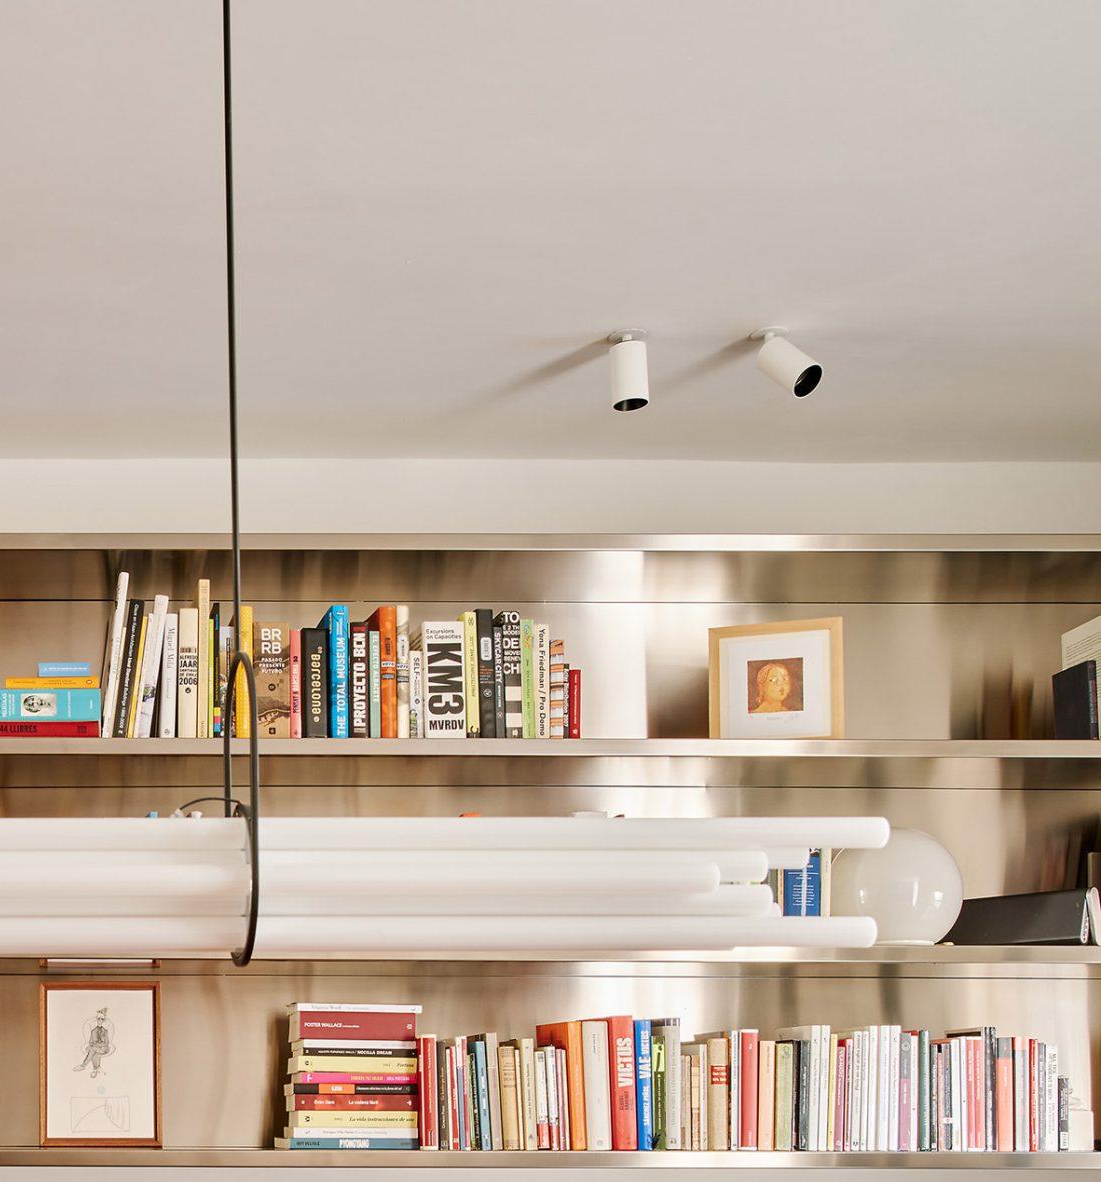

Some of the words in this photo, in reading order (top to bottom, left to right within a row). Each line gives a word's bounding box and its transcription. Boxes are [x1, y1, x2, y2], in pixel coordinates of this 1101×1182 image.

[503, 611, 519, 623] TO
[261, 628, 282, 641] BR
[353, 632, 366, 657] BCN
[503, 638, 519, 650] DE
[261, 641, 282, 655] RB
[335, 637, 345, 679] MUSEUM
[493, 632, 502, 665] SKYCAR
[179, 660, 198, 668] JAAR
[494, 665, 502, 683] CITY
[503, 663, 520, 674] CH
[310, 653, 321, 714] Barcelona
[427, 643, 465, 715] KM3
[336, 681, 346, 712] TOTAL
[352, 662, 366, 726] PROYECTO
[9, 724, 38, 734] LLIBRES
[336, 715, 346, 736] THE
[429, 719, 464, 731] MVRDV
[639, 1030, 649, 1054] VICTUS
[616, 1036, 634, 1088] VICTUS
[638, 1055, 651, 1079] VAE
